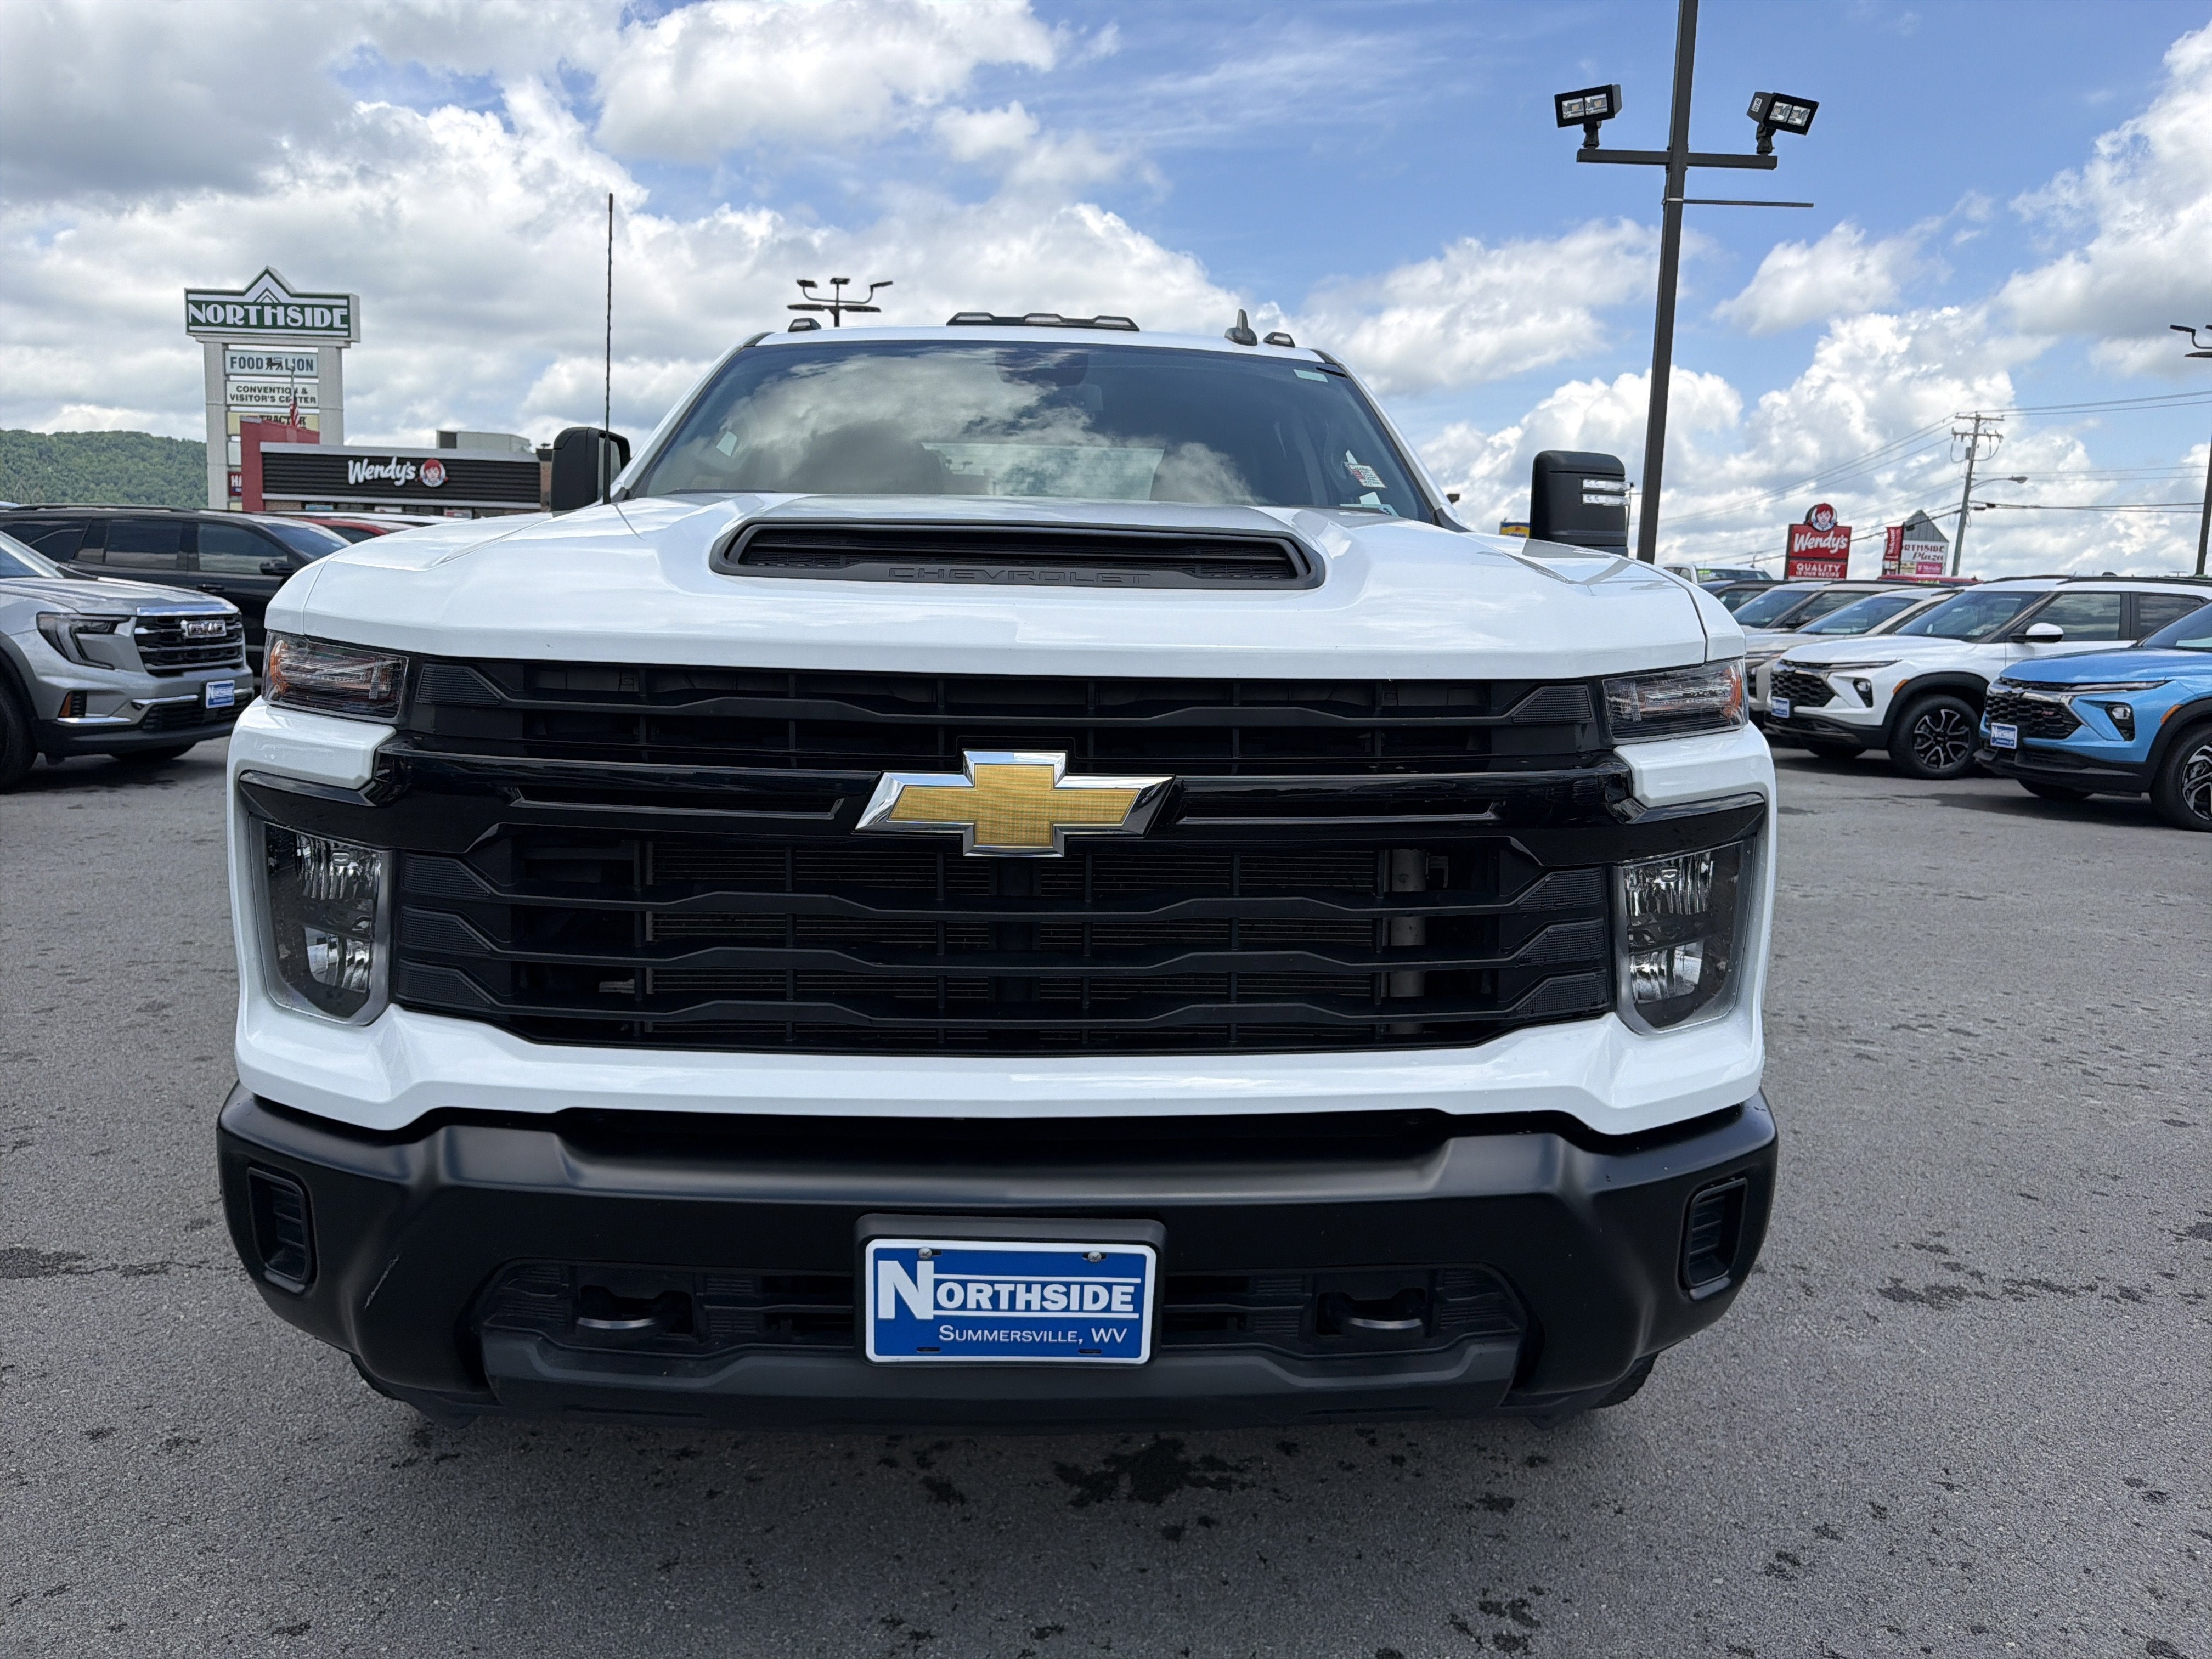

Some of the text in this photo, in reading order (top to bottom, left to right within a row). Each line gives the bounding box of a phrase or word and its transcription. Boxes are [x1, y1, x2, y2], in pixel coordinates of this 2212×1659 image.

[188, 303, 348, 328] NORTHSIDE
[230, 357, 313, 371] FOOD LION
[229, 393, 317, 404] VISITOR'S CETER
[259, 415, 306, 425] TRACTR
[348, 456, 416, 486] Wendy's
[1793, 530, 1848, 554] Wendy's
[1902, 544, 1945, 553] RTHSIDE
[1912, 552, 1944, 561] Plaza
[1796, 562, 1841, 572] QUALITY
[888, 567, 1150, 584] CHEVROLET
[878, 1260, 1135, 1319] NORTHSIDE
[939, 1324, 1128, 1345] SUMMERSVILLE, WV
